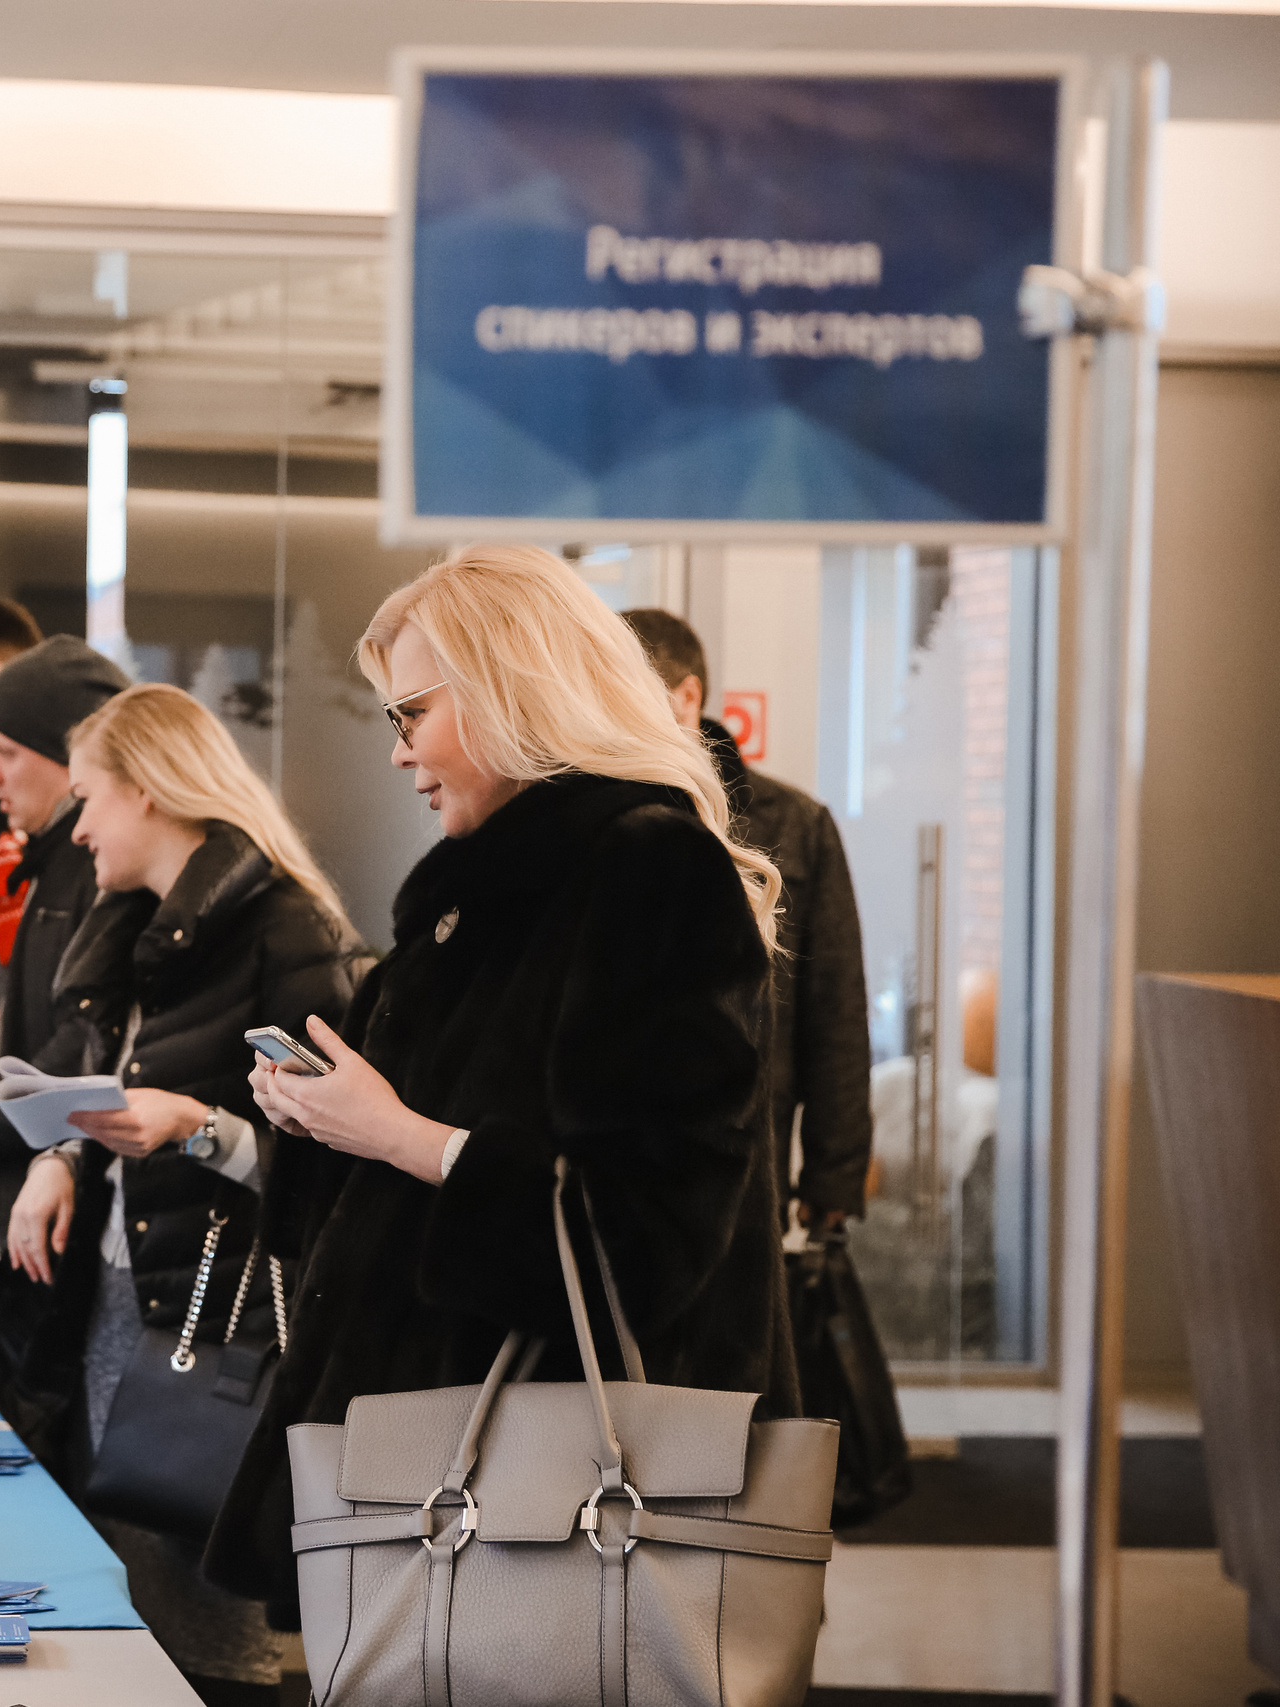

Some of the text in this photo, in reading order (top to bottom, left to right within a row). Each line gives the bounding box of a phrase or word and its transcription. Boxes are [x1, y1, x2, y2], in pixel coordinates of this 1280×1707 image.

[586, 226, 882, 294] Регистрация
[475, 306, 984, 368] спикеров и экспертов
